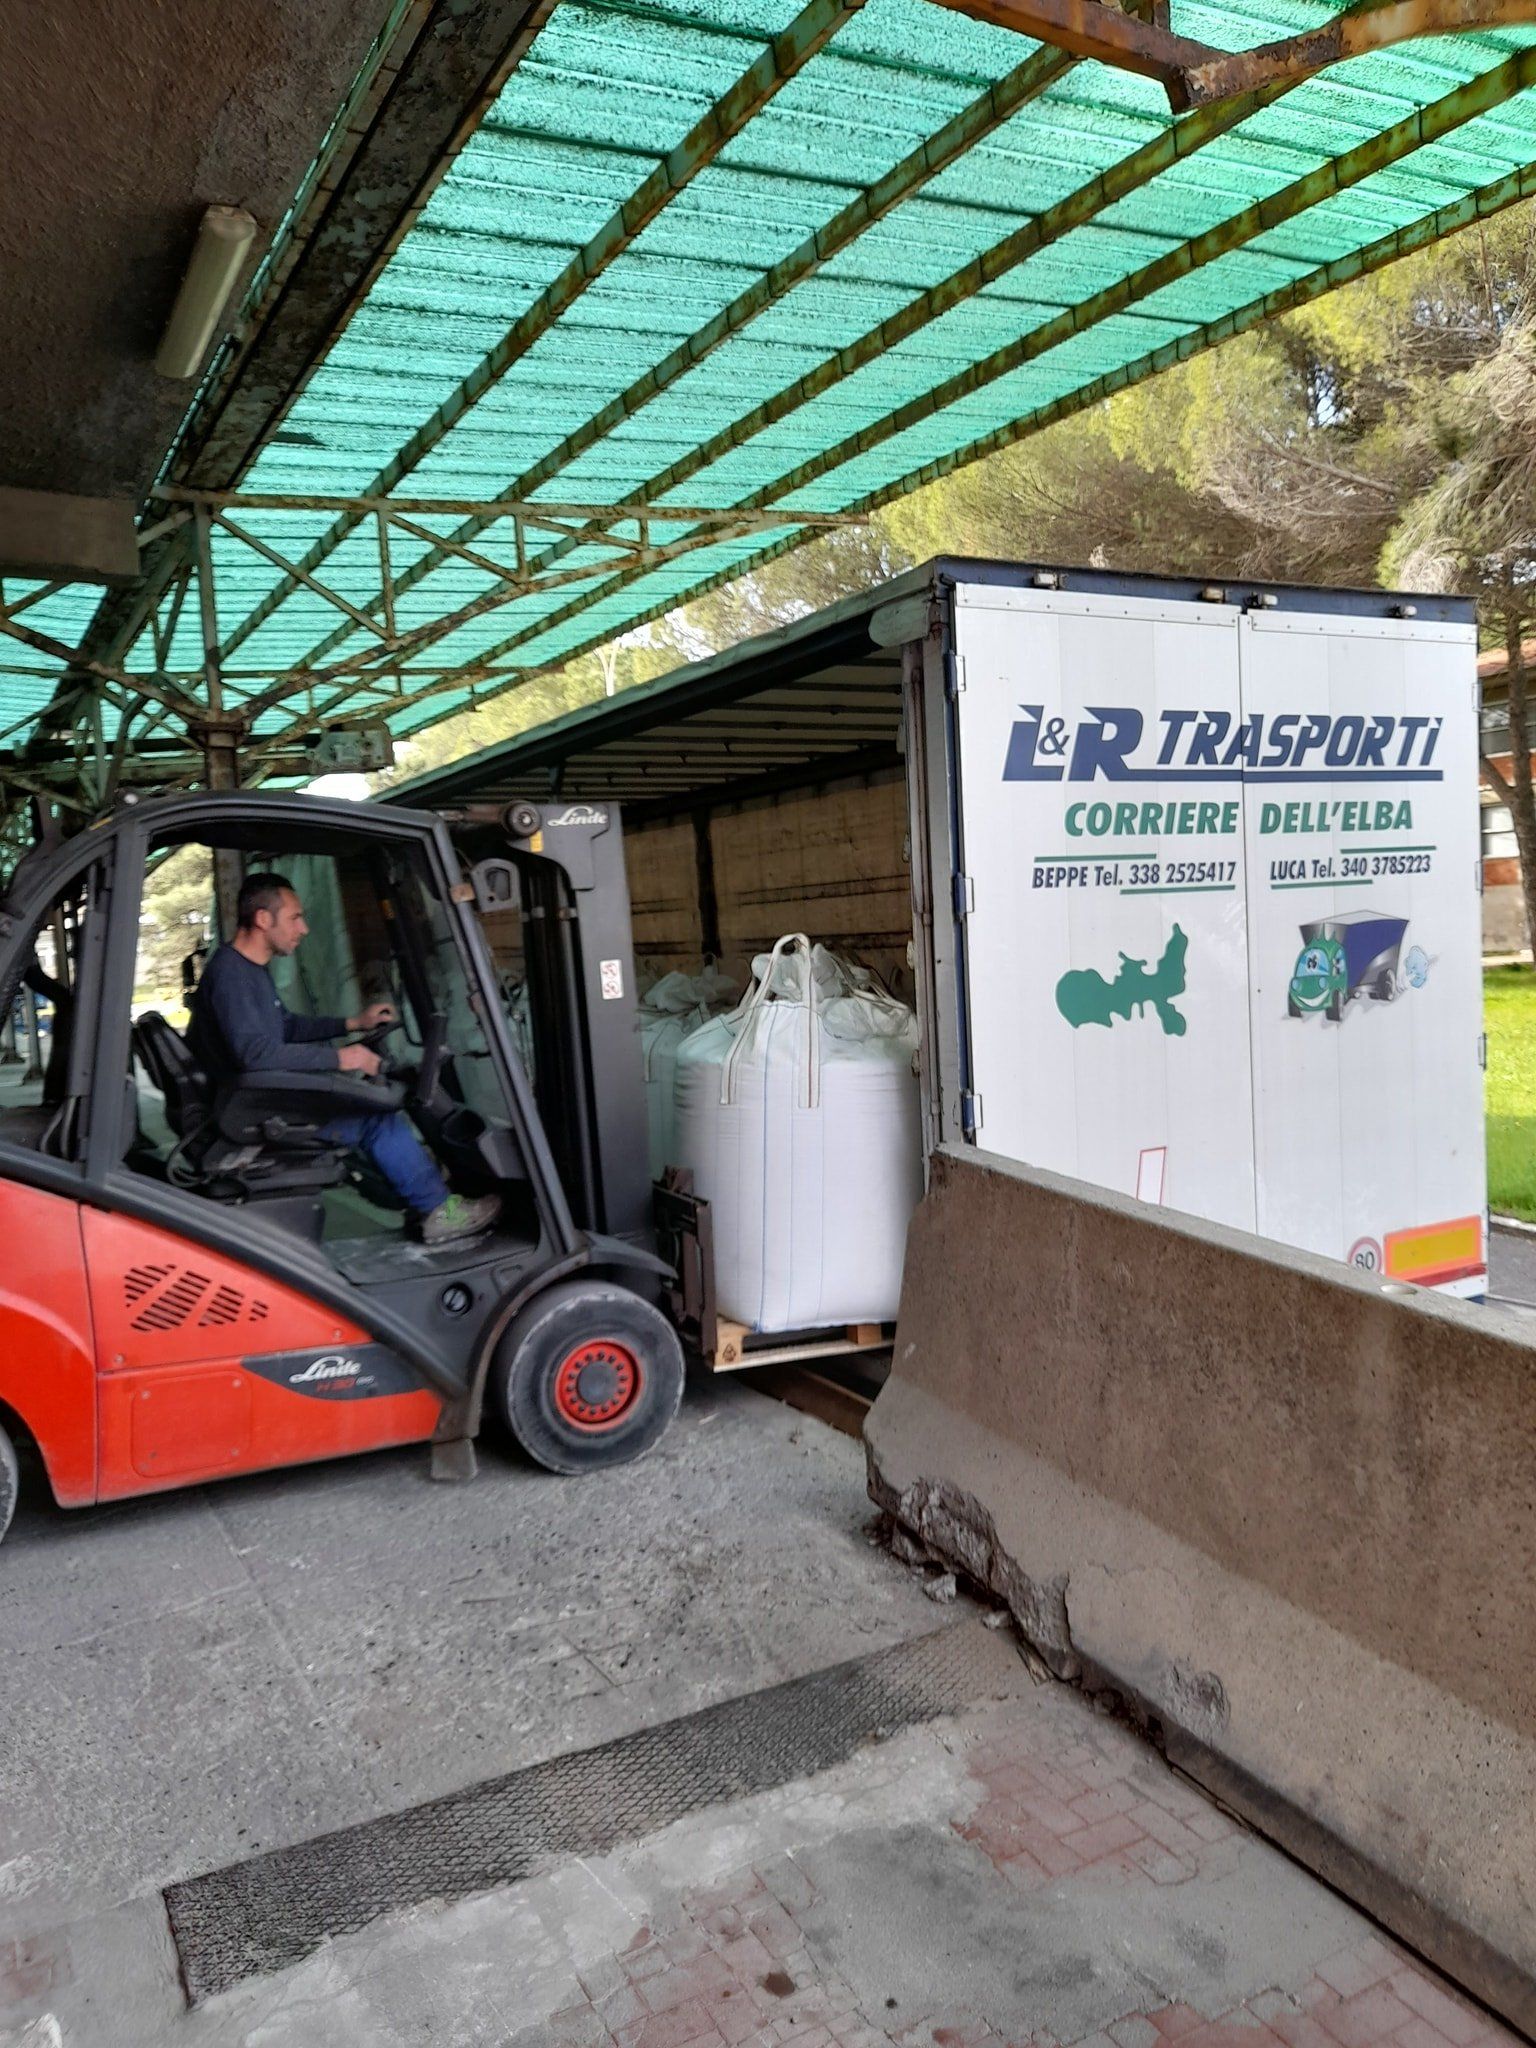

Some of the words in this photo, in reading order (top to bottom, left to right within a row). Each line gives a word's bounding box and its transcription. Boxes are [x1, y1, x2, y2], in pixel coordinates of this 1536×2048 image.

[1002, 704, 1144, 781] L&R
[1157, 709, 1443, 767] TRASPORTI
[547, 805, 608, 827] Linde
[1065, 801, 1240, 836] CORRIERE
[1259, 800, 1413, 834] DELL'ELBA
[1032, 866, 1088, 888] BEPPE
[1094, 864, 1123, 886] Tel.
[1129, 863, 1160, 885] 338
[1165, 861, 1236, 883] 2525417
[1270, 859, 1307, 880] LUCA
[1312, 857, 1336, 878] Tel.
[1340, 857, 1368, 877] 340
[1371, 854, 1431, 875] 3785223
[289, 1355, 361, 1383] Linde
